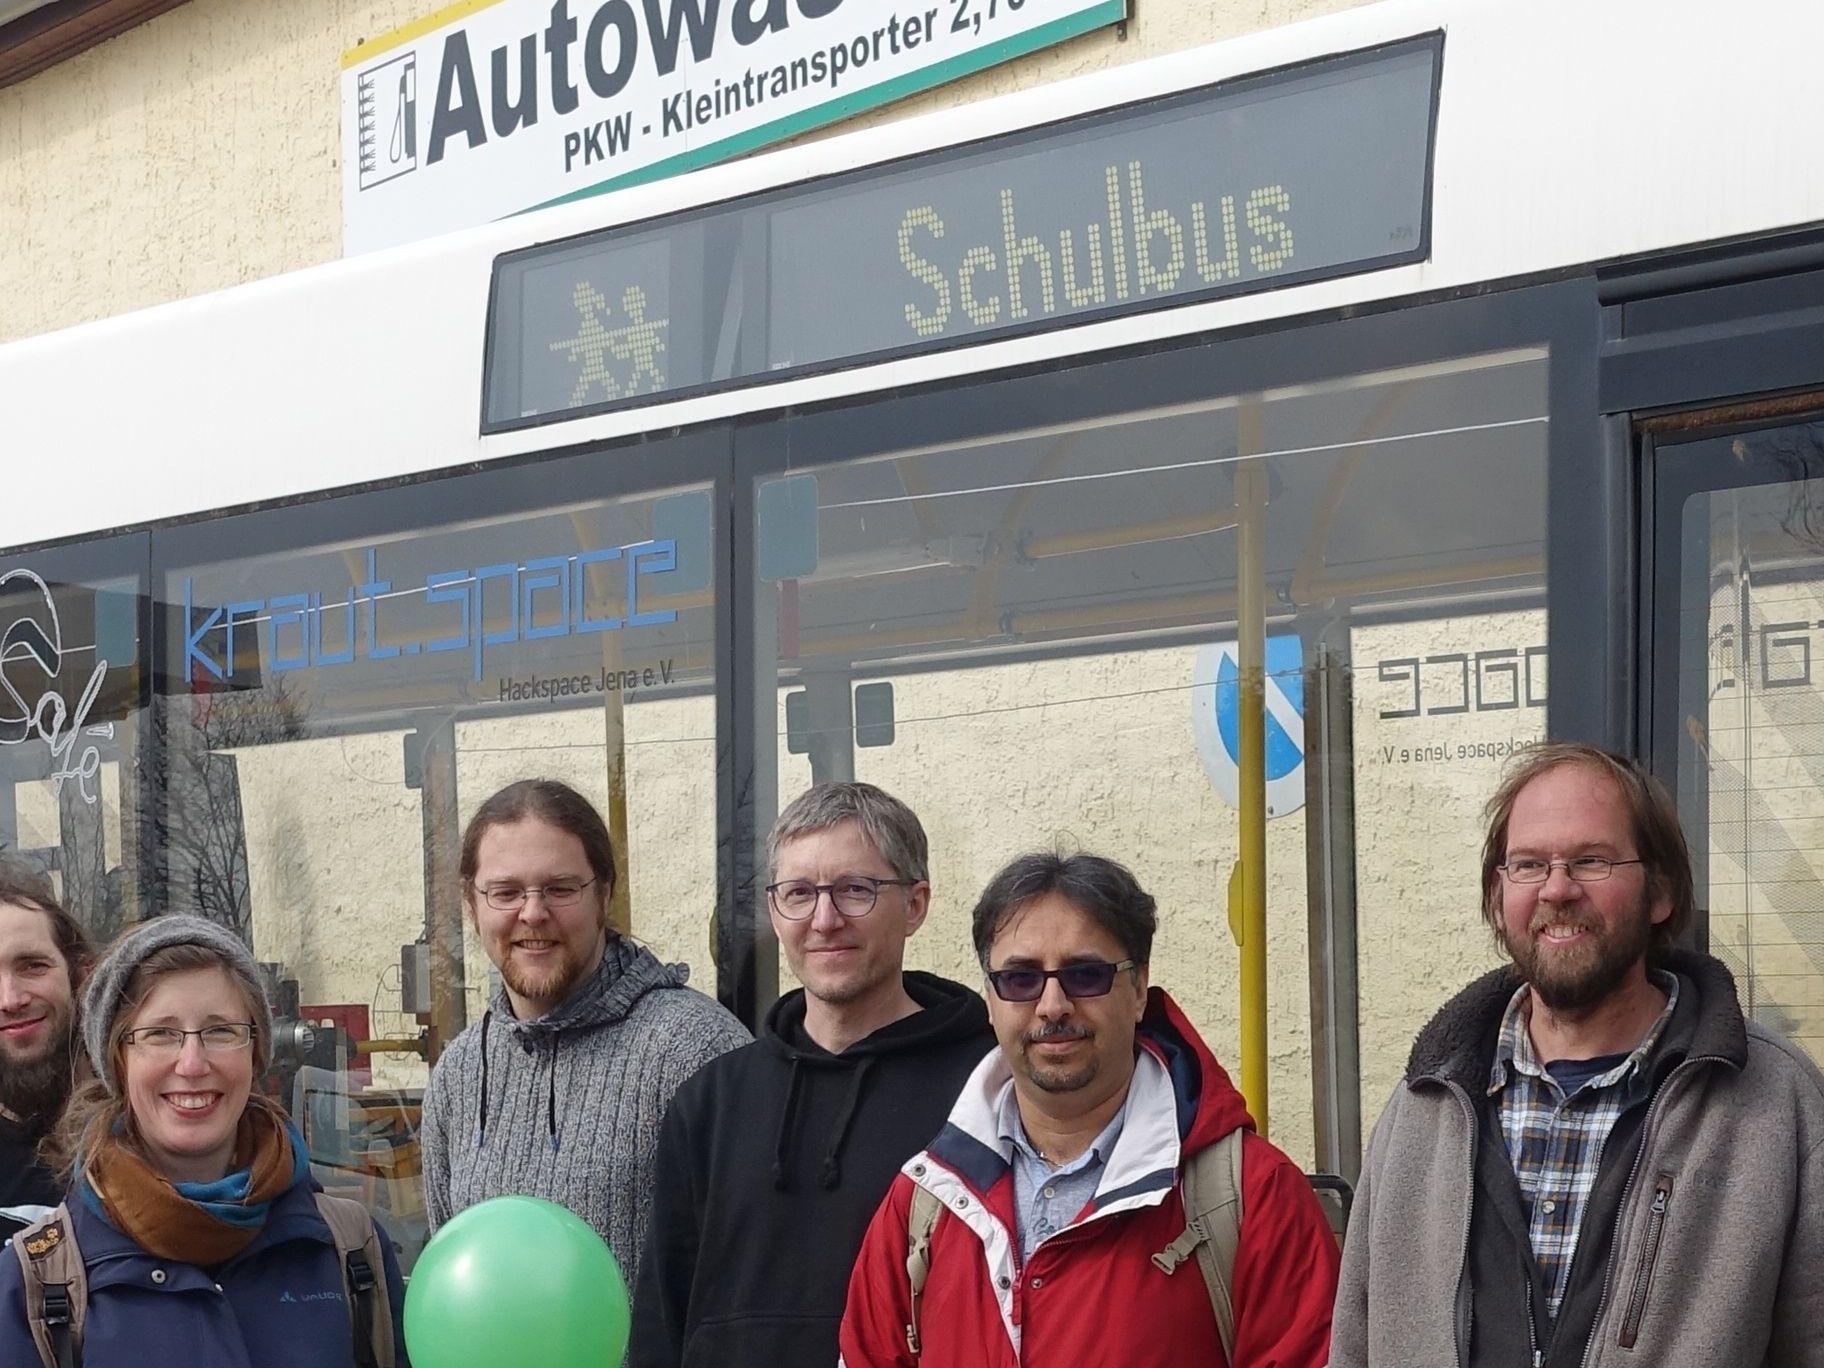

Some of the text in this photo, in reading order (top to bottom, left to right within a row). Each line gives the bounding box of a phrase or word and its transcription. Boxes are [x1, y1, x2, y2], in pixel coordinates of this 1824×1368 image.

[564, 111, 634, 173] PKW
[662, 10, 938, 137] Kleintransporter
[896, 159, 1295, 337] Schulbus
[183, 538, 678, 683] kraut.space
[499, 675, 592, 704] Hackspace
[595, 667, 639, 692] Jena
